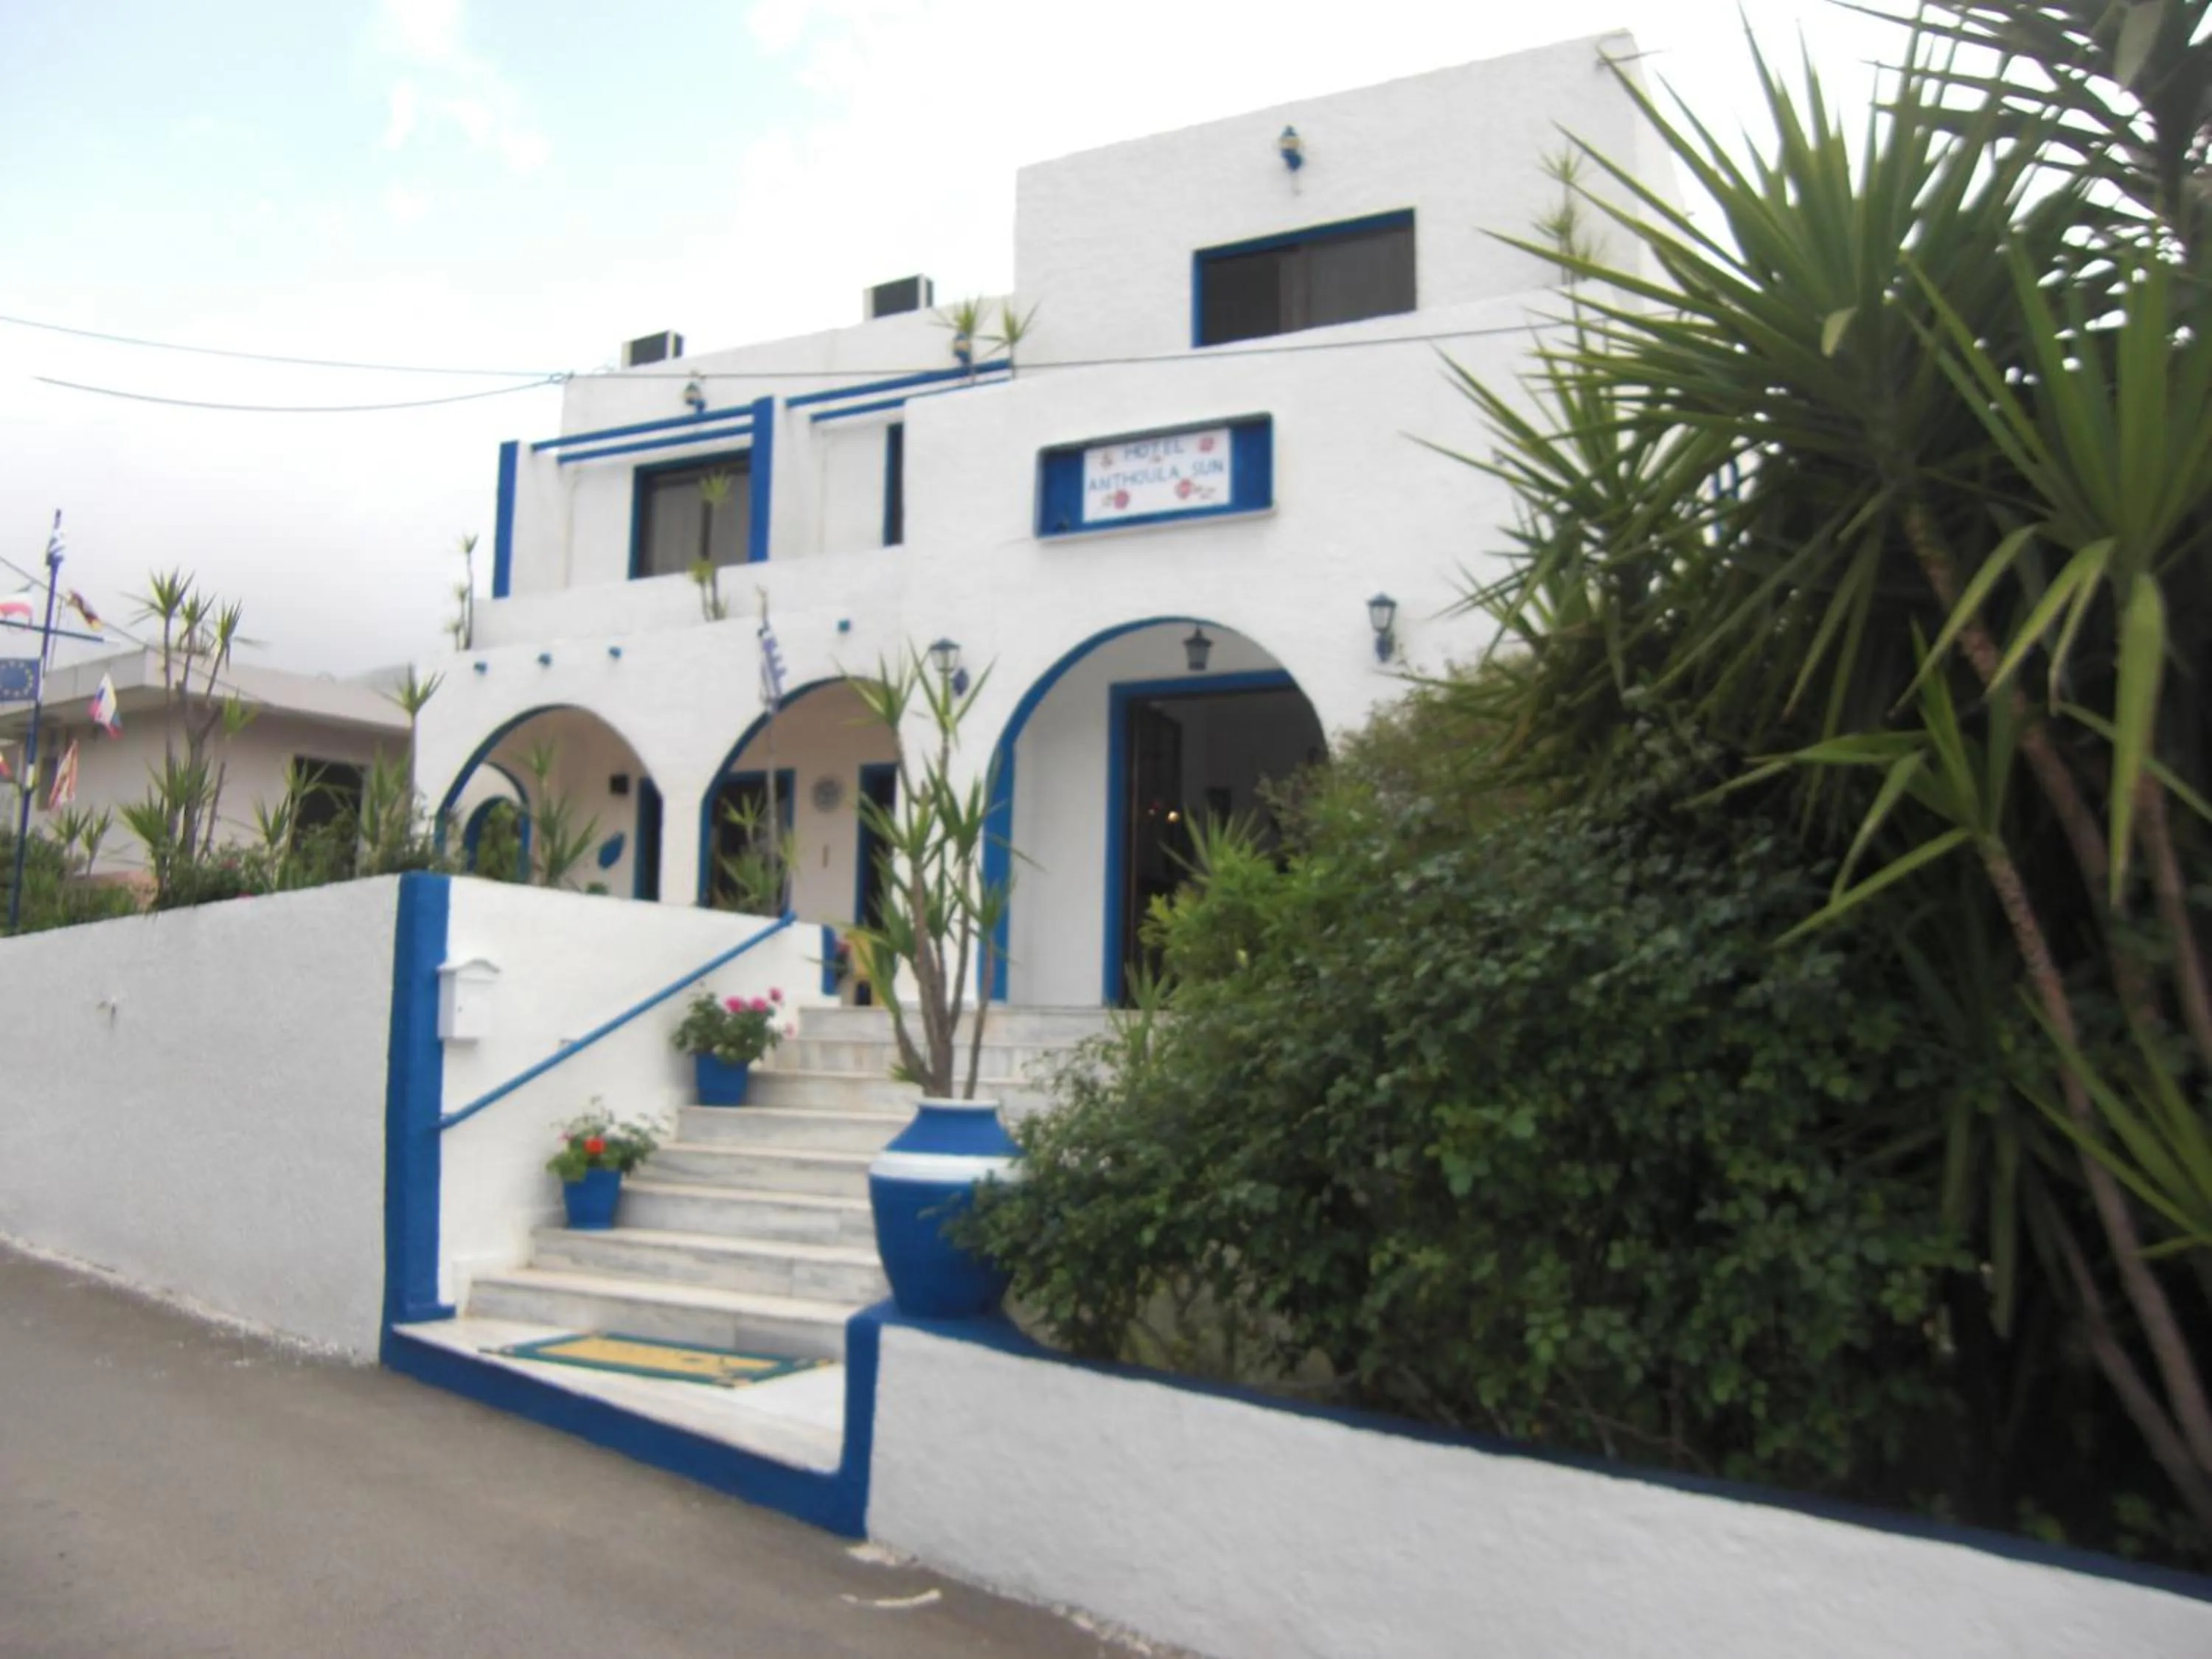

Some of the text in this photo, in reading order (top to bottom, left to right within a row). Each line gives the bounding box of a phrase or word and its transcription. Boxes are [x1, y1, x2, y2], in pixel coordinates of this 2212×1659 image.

[1124, 440, 1185, 459] HOTEL
[1089, 459, 1224, 491] ANTHOULA SUN
